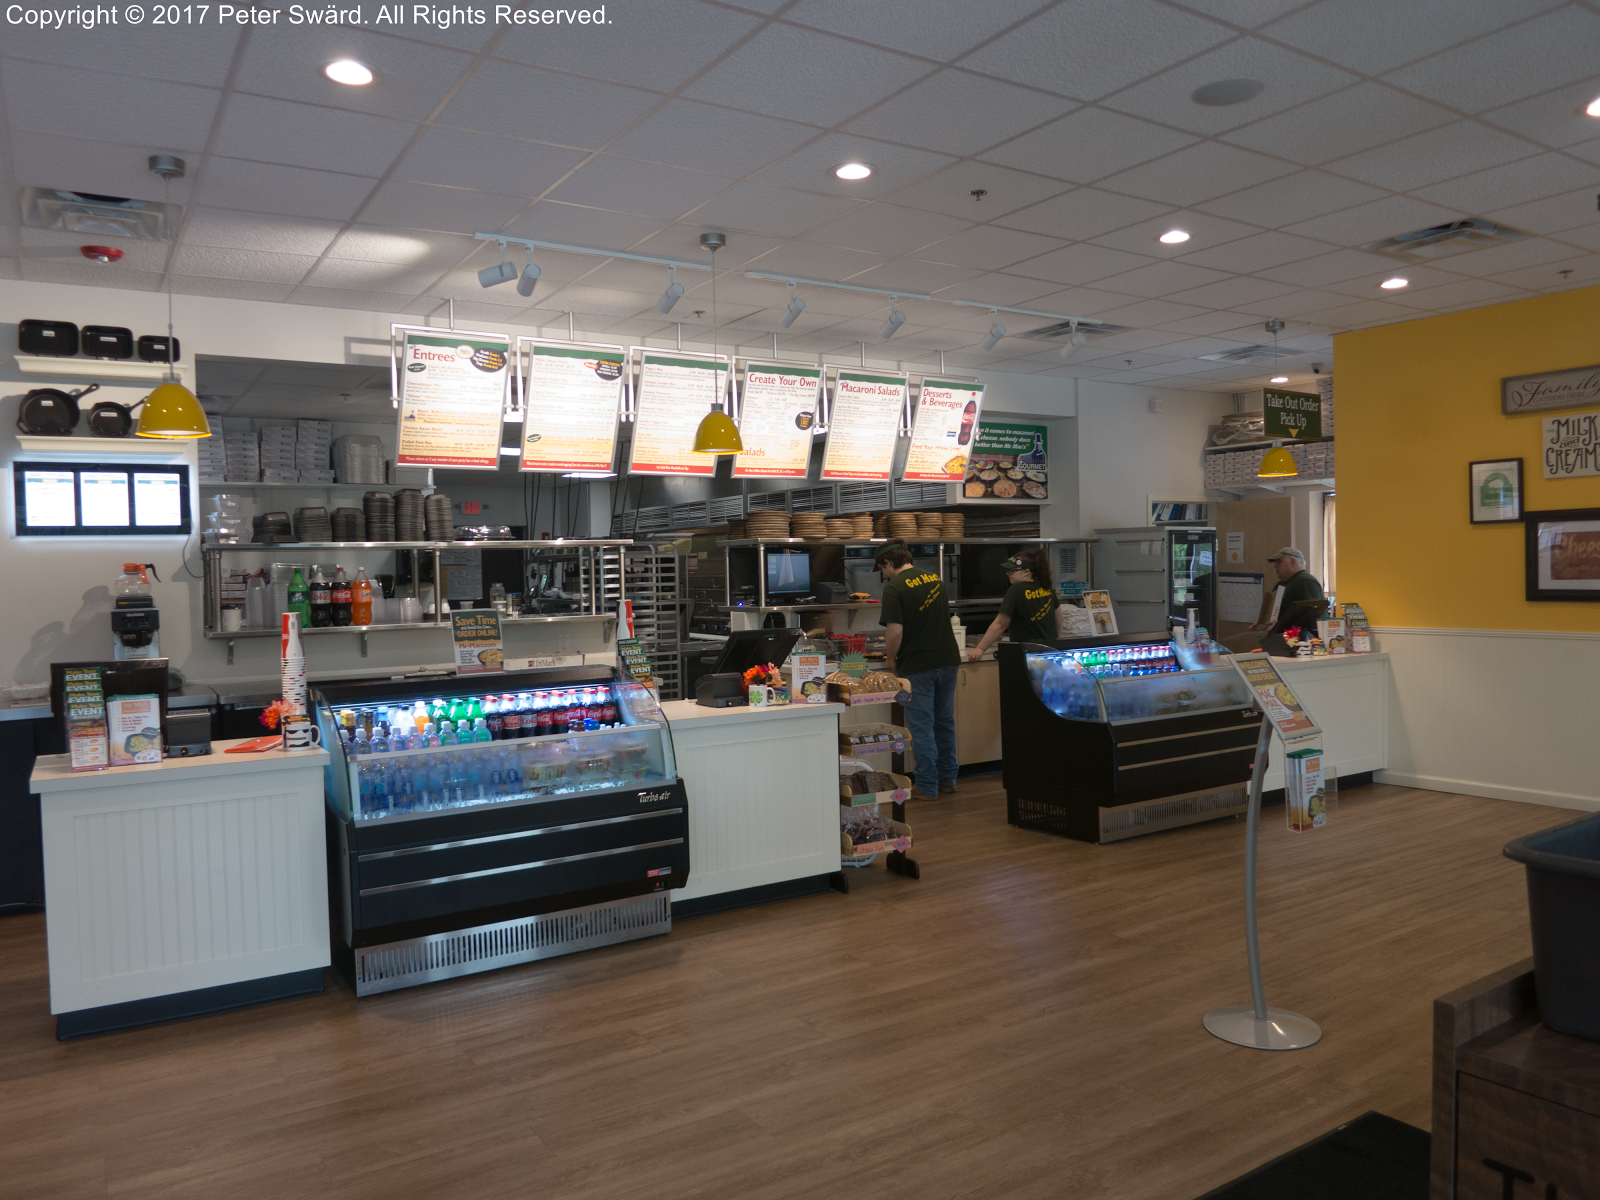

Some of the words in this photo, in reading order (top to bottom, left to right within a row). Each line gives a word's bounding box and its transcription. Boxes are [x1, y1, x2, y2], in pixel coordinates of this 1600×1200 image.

[413, 348, 456, 363] Entrees
[749, 373, 776, 385] Create
[778, 375, 798, 386] Your
[799, 377, 817, 388] Own
[841, 383, 877, 394] Macaroni
[877, 385, 900, 397] Salads
[923, 388, 952, 399] Desserts
[1266, 393, 1284, 408] Take
[1284, 396, 1299, 410] Out
[1299, 397, 1319, 412] Order
[1533, 394, 1565, 403] GATHERS
[1566, 391, 1584, 399] HERE
[921, 397, 927, 406] &
[929, 397, 963, 411] Beverages
[1280, 411, 1295, 426] Pick
[1296, 413, 1307, 430] Up
[1550, 415, 1598, 446] MILK
[999, 435, 1018, 443] nobody
[1546, 443, 1600, 475] CREAM
[464, 501, 481, 514] EXIT
[905, 576, 922, 588] Got
[1025, 589, 1040, 600] Got
[455, 616, 476, 627] Save
[476, 615, 497, 625] Time
[457, 630, 477, 638] ORDER
[476, 629, 498, 637] ONLINE!
[621, 648, 643, 656] EVENT
[626, 657, 647, 665] EVENT
[1238, 659, 1270, 670] WELCOME!
[630, 666, 652, 674] EVENT
[65, 672, 98, 682] EVENT
[1247, 674, 1263, 682] GOOD
[1263, 671, 1278, 680] DEAL!
[66, 684, 100, 692] EVENT
[1256, 688, 1275, 699] MAC
[68, 695, 102, 704] EVENT
[1262, 698, 1282, 708] MAIL
[71, 707, 103, 717] EVENT
[637, 791, 659, 803] Turbo
[659, 791, 672, 801] air
